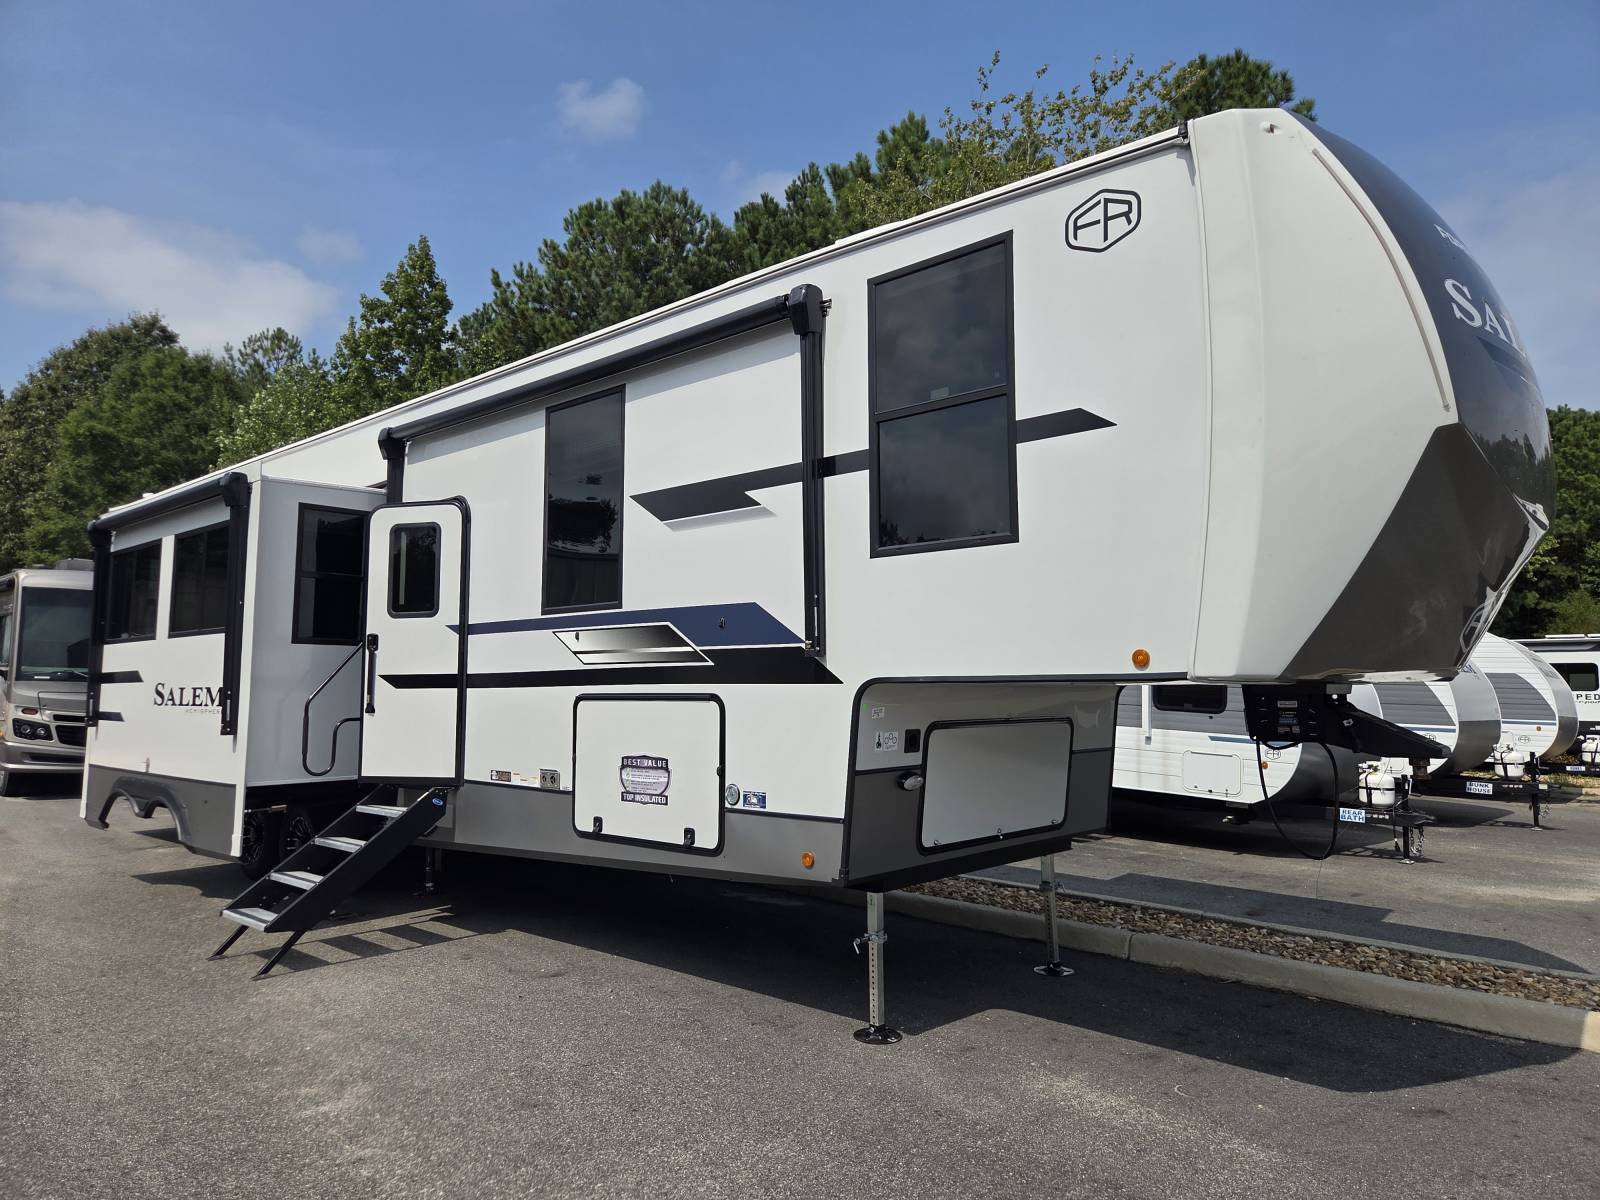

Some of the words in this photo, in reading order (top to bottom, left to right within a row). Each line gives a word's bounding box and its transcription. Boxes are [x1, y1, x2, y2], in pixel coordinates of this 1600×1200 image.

[1444, 278, 1526, 358] SAL
[153, 682, 223, 707] SALEM
[623, 758, 641, 766] BEST
[643, 759, 667, 768] VALUE
[623, 793, 634, 801] TOP
[635, 794, 667, 804] INSULATED
[1341, 814, 1364, 822] BATH
